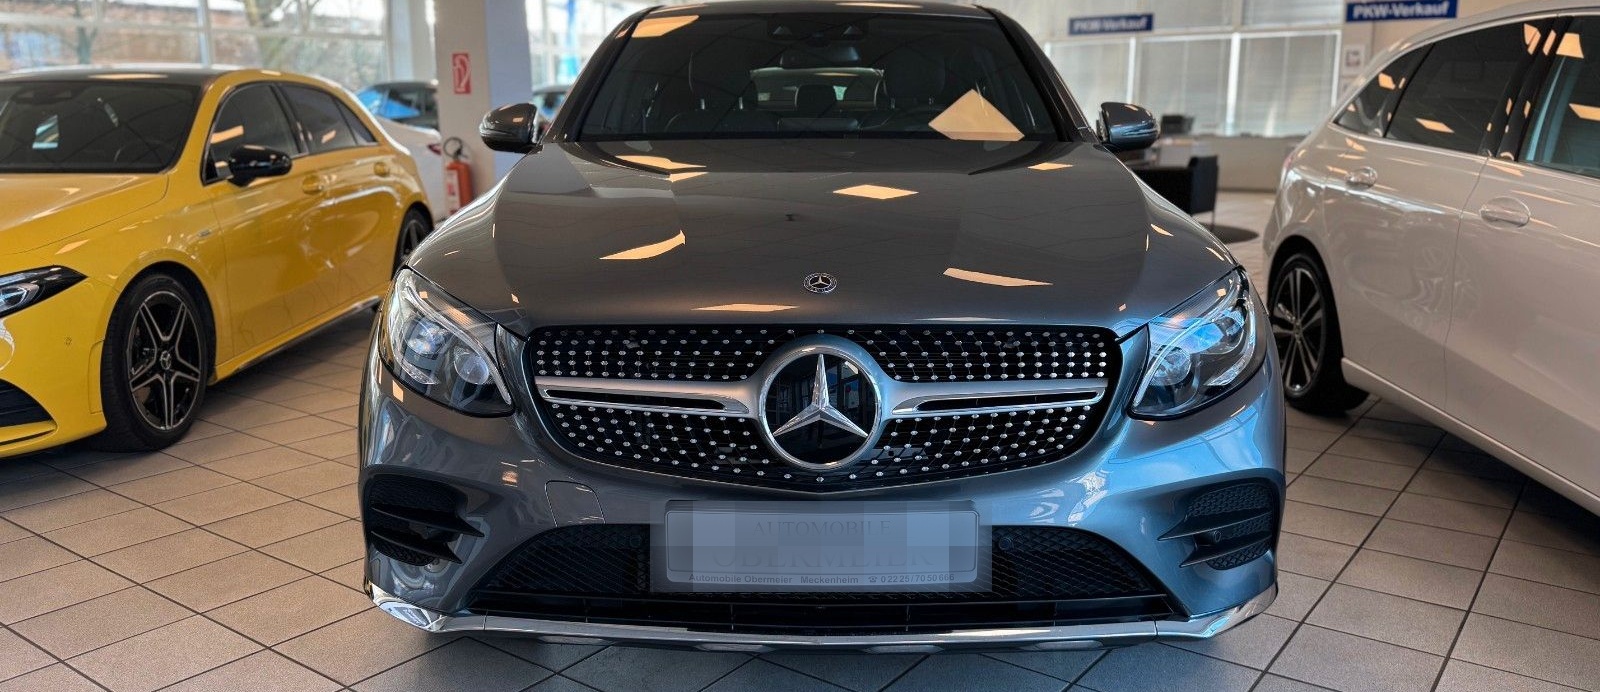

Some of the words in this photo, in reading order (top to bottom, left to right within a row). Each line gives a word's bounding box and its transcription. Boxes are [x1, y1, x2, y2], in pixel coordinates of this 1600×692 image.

[1352, 1, 1450, 19] PKW-Verkauf
[752, 520, 892, 537] AUTOMOBILE
[688, 573, 742, 584] Automobile
[744, 575, 793, 584] Obermeier
[800, 575, 859, 584] Meckenheim
